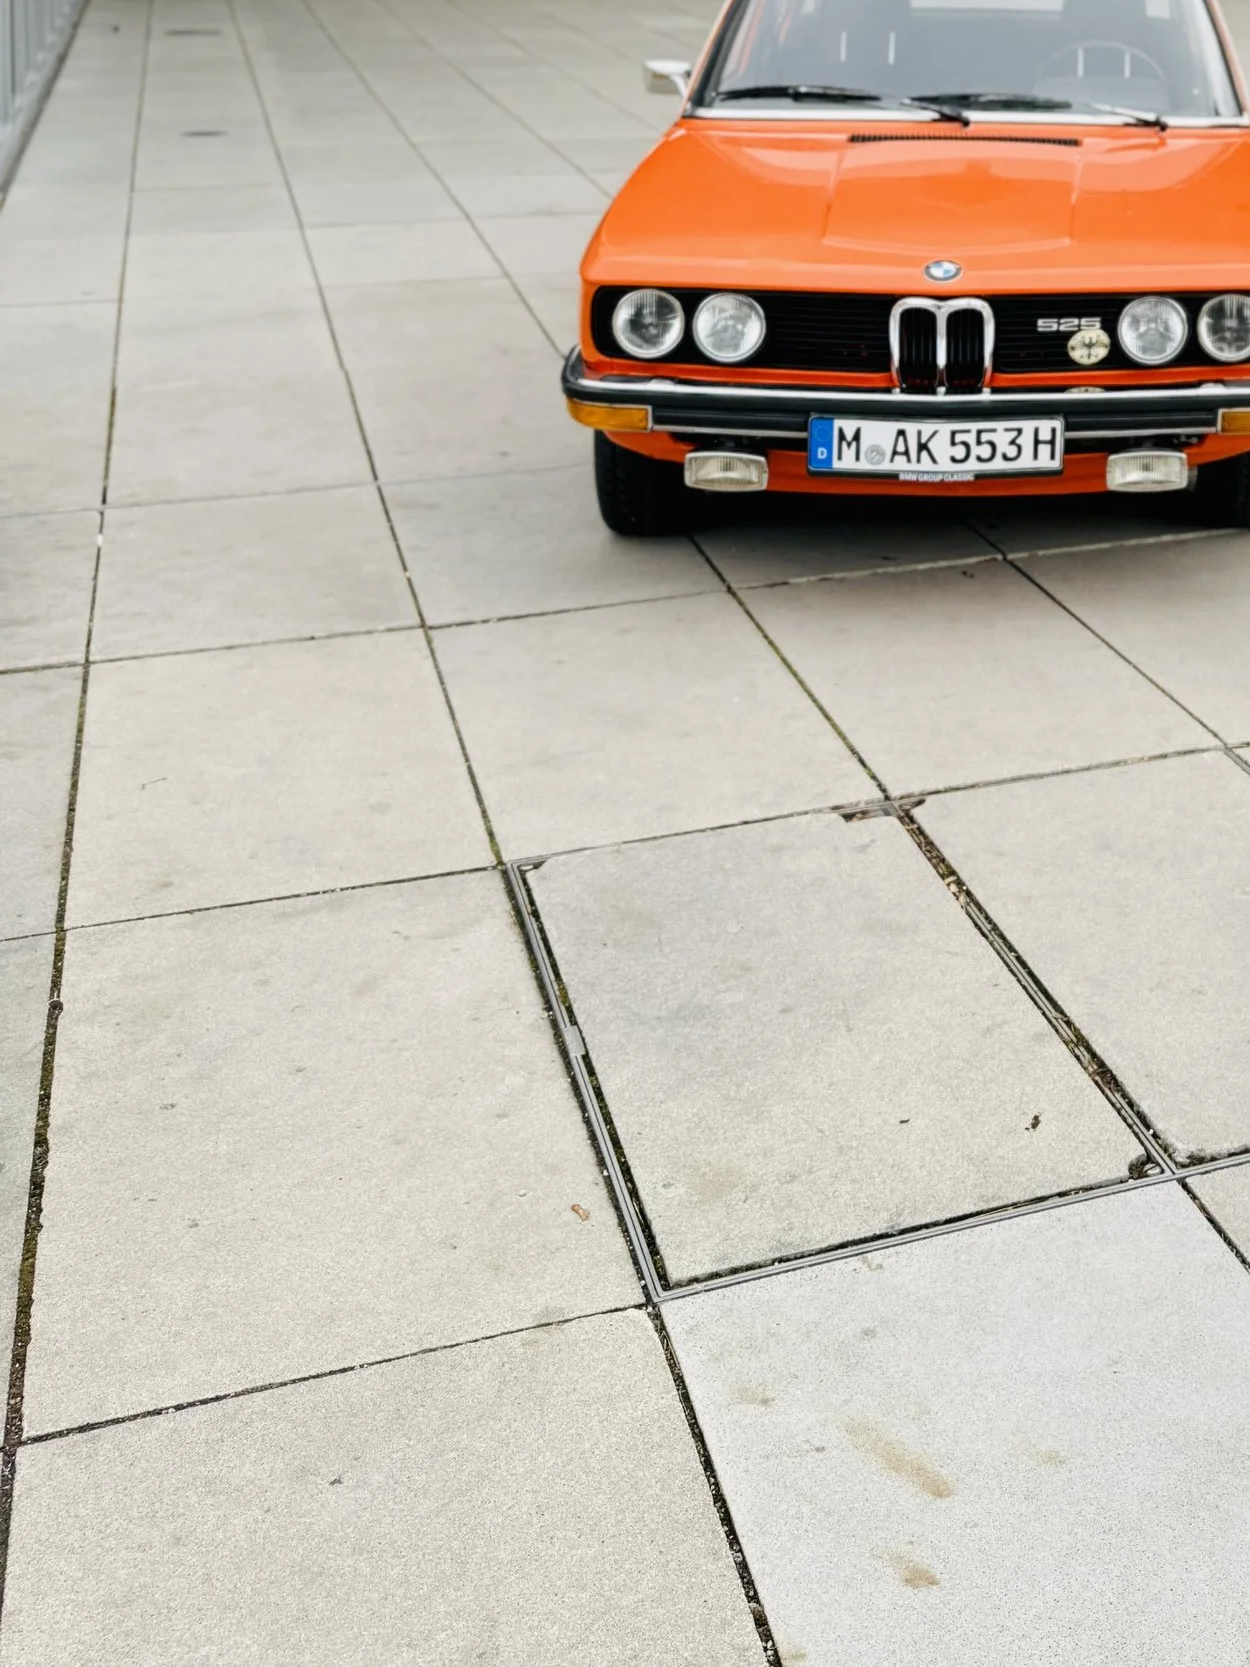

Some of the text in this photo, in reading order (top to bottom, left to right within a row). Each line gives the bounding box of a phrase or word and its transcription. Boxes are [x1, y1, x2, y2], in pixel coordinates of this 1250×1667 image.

[1037, 317, 1101, 332] 525
[837, 426, 862, 463] M
[889, 427, 939, 465] AK
[817, 447, 827, 460] D
[899, 472, 975, 483] BMW GROUP CLASSIC
